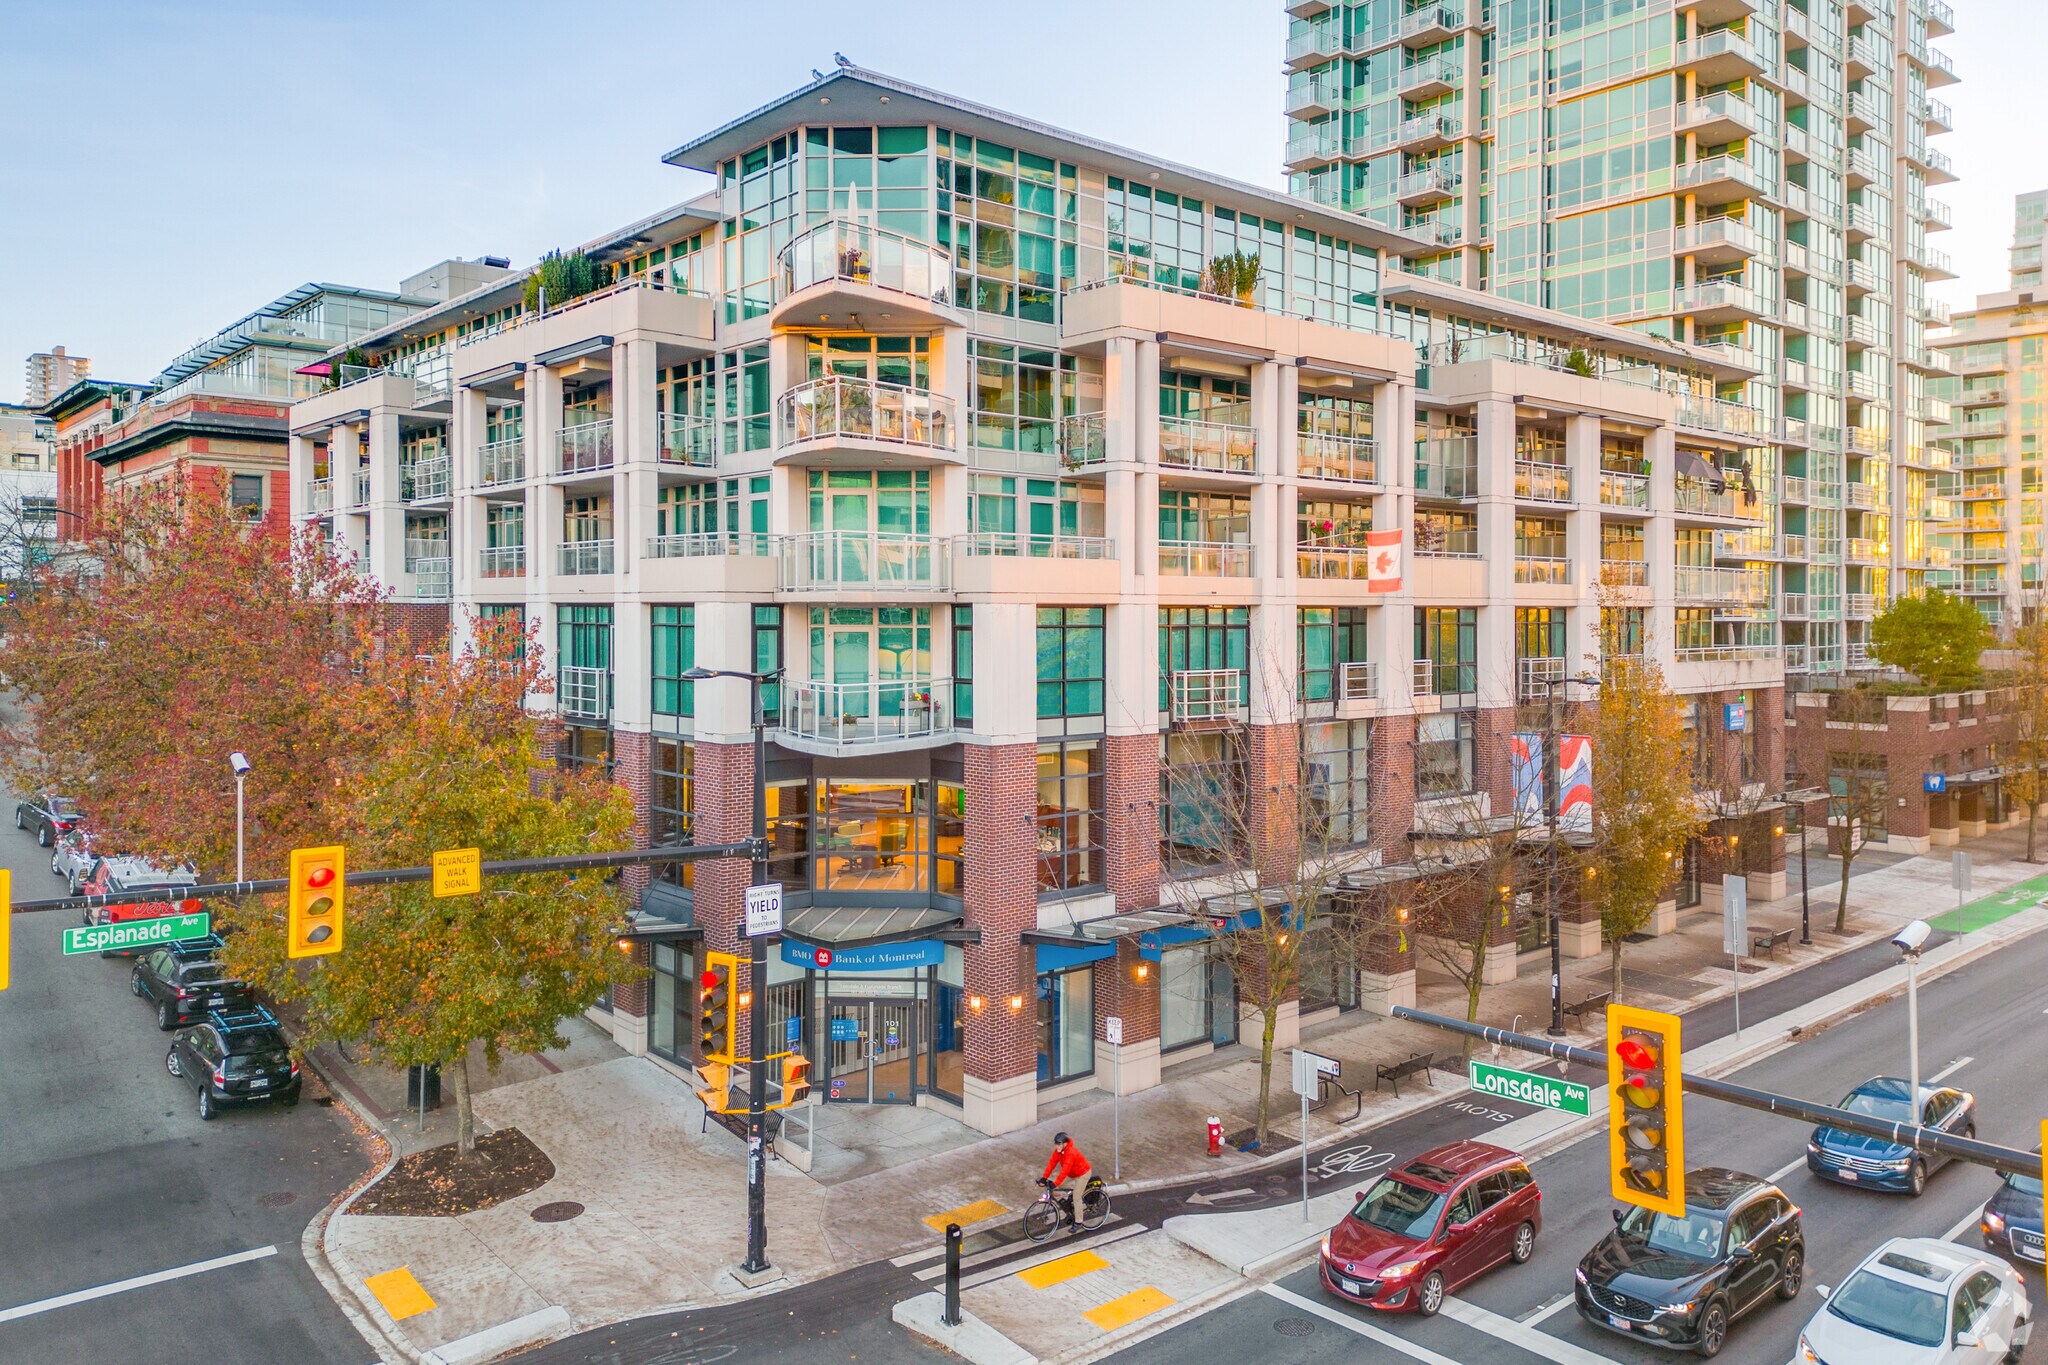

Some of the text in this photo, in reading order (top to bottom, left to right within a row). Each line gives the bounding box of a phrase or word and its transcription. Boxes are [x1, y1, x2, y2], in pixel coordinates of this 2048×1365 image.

[438, 855, 475, 866] ADVANCED
[446, 867, 468, 877] WALK
[444, 878, 470, 889] SIGNAL
[750, 898, 778, 913] YIELD
[750, 920, 779, 929] PEDESTRIANS
[72, 916, 199, 950] Esplanade Ave
[792, 949, 925, 964] BMO Bank of Montreal
[1472, 1065, 1585, 1107] Lonsdale Ave
[1447, 1101, 1515, 1123] SLOW
